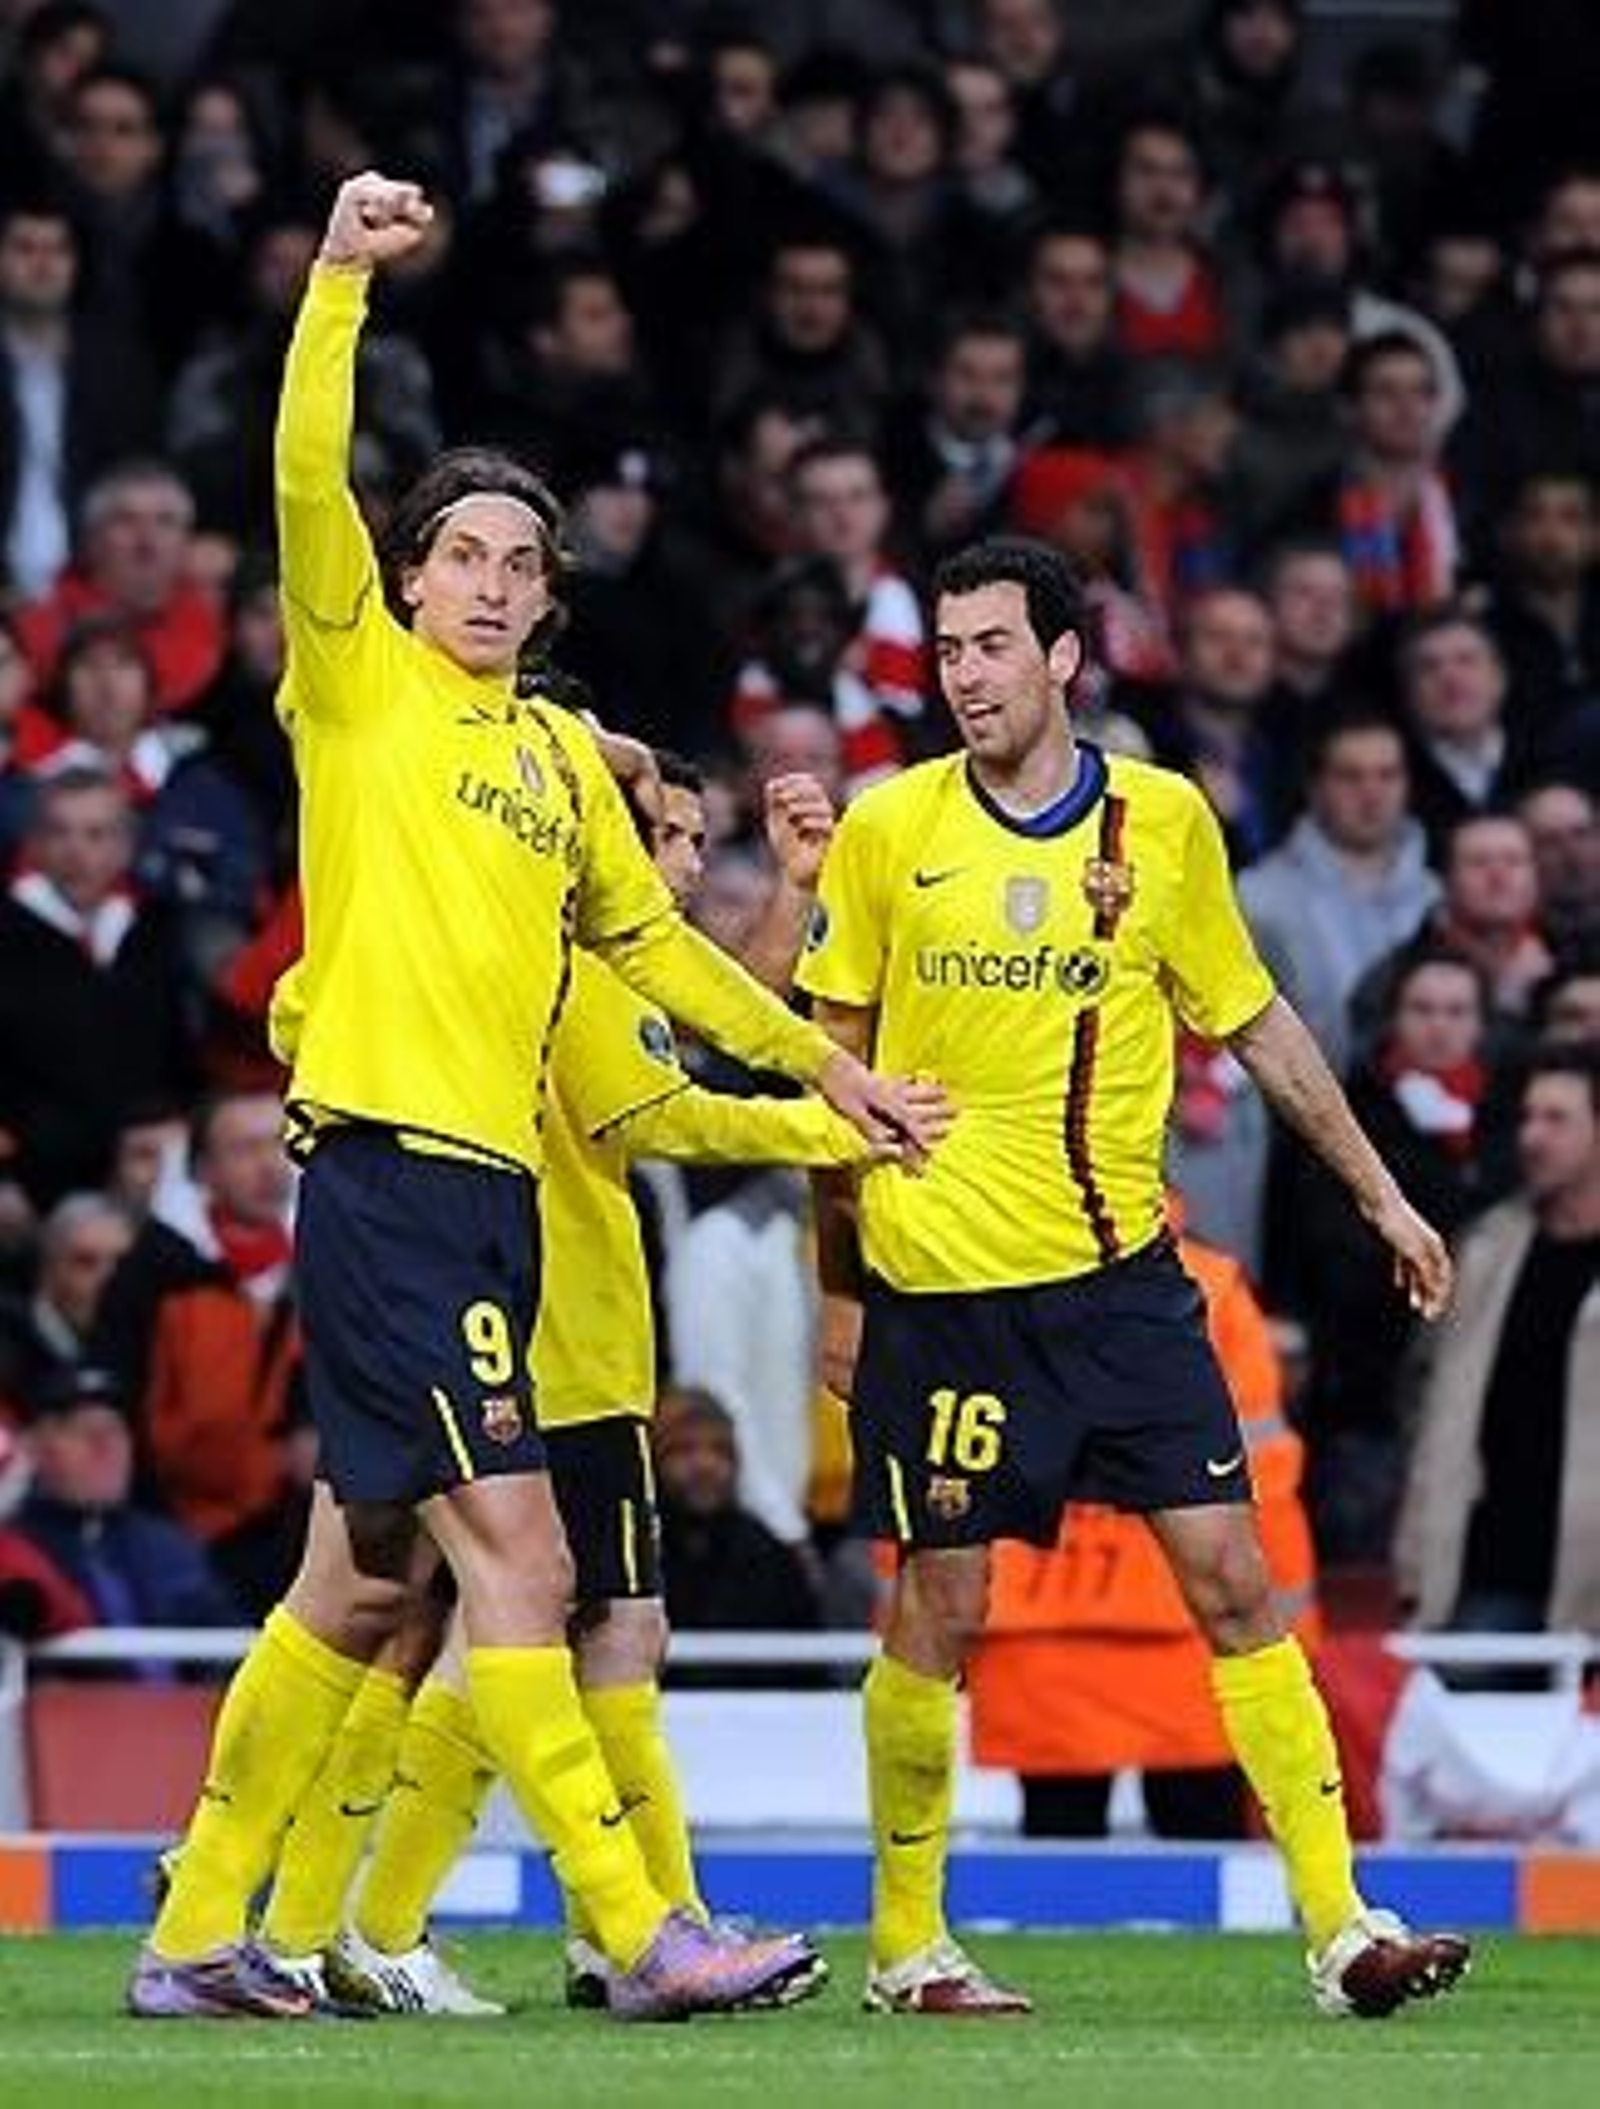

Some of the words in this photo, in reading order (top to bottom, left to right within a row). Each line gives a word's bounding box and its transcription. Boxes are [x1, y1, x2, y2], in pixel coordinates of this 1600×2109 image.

[456, 772, 563, 857] unicef
[916, 940, 1053, 990] unicef
[462, 1300, 514, 1387] 9
[926, 1387, 1007, 1472] 16
